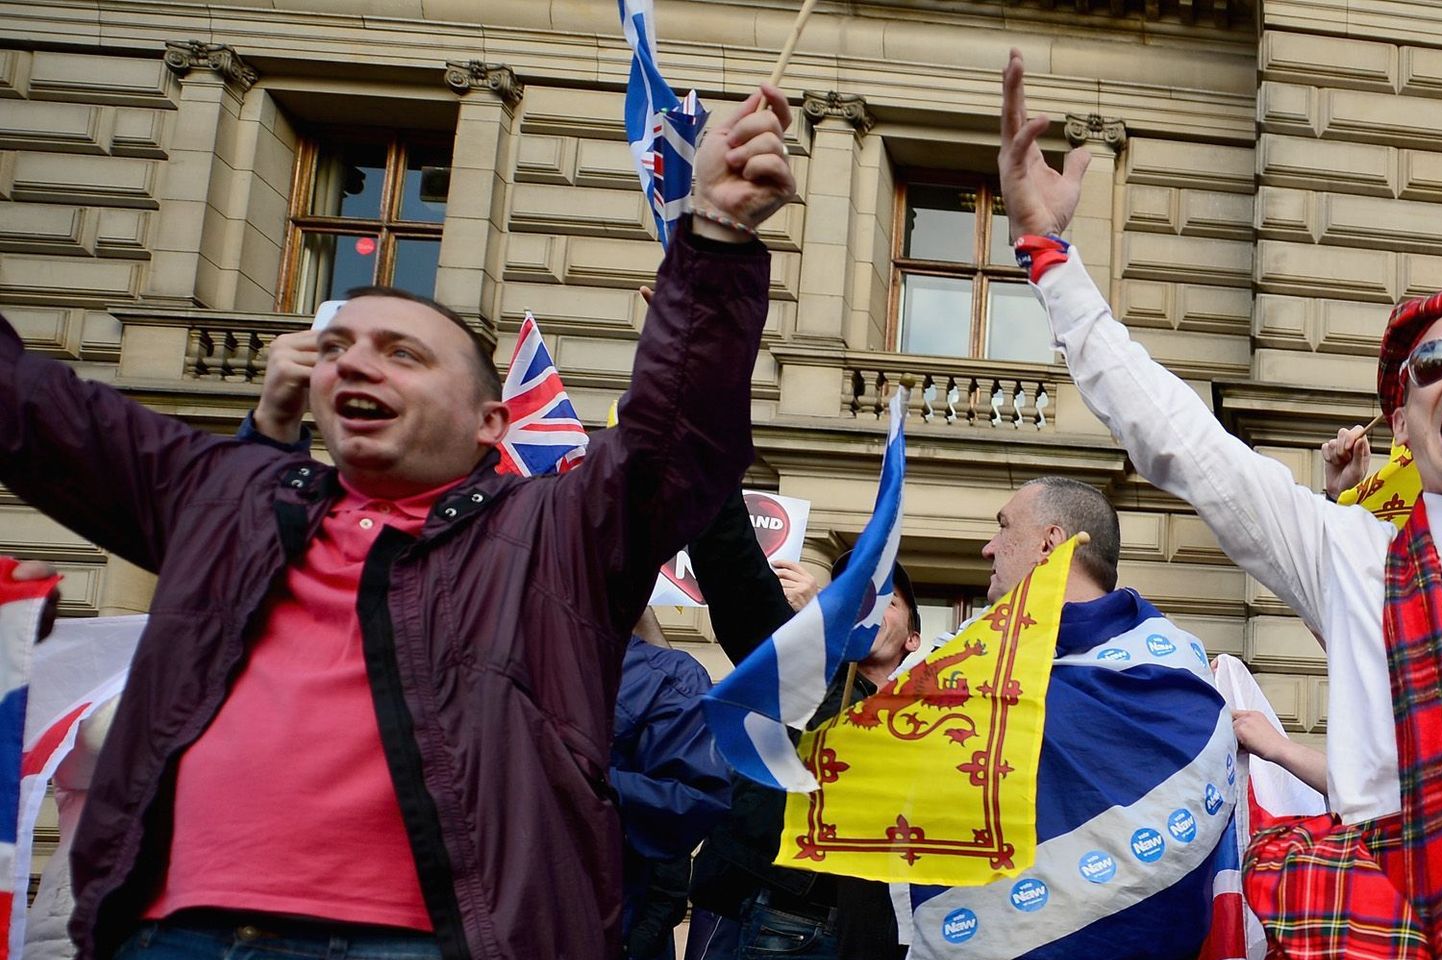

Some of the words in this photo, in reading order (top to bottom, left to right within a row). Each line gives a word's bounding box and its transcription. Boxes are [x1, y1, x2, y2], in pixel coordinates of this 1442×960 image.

[1169, 816, 1194, 836] Naw
[1132, 835, 1162, 855] Naw
[1081, 857, 1113, 876] Naw
[1012, 885, 1046, 904] Naw
[944, 918, 976, 936] Naw
